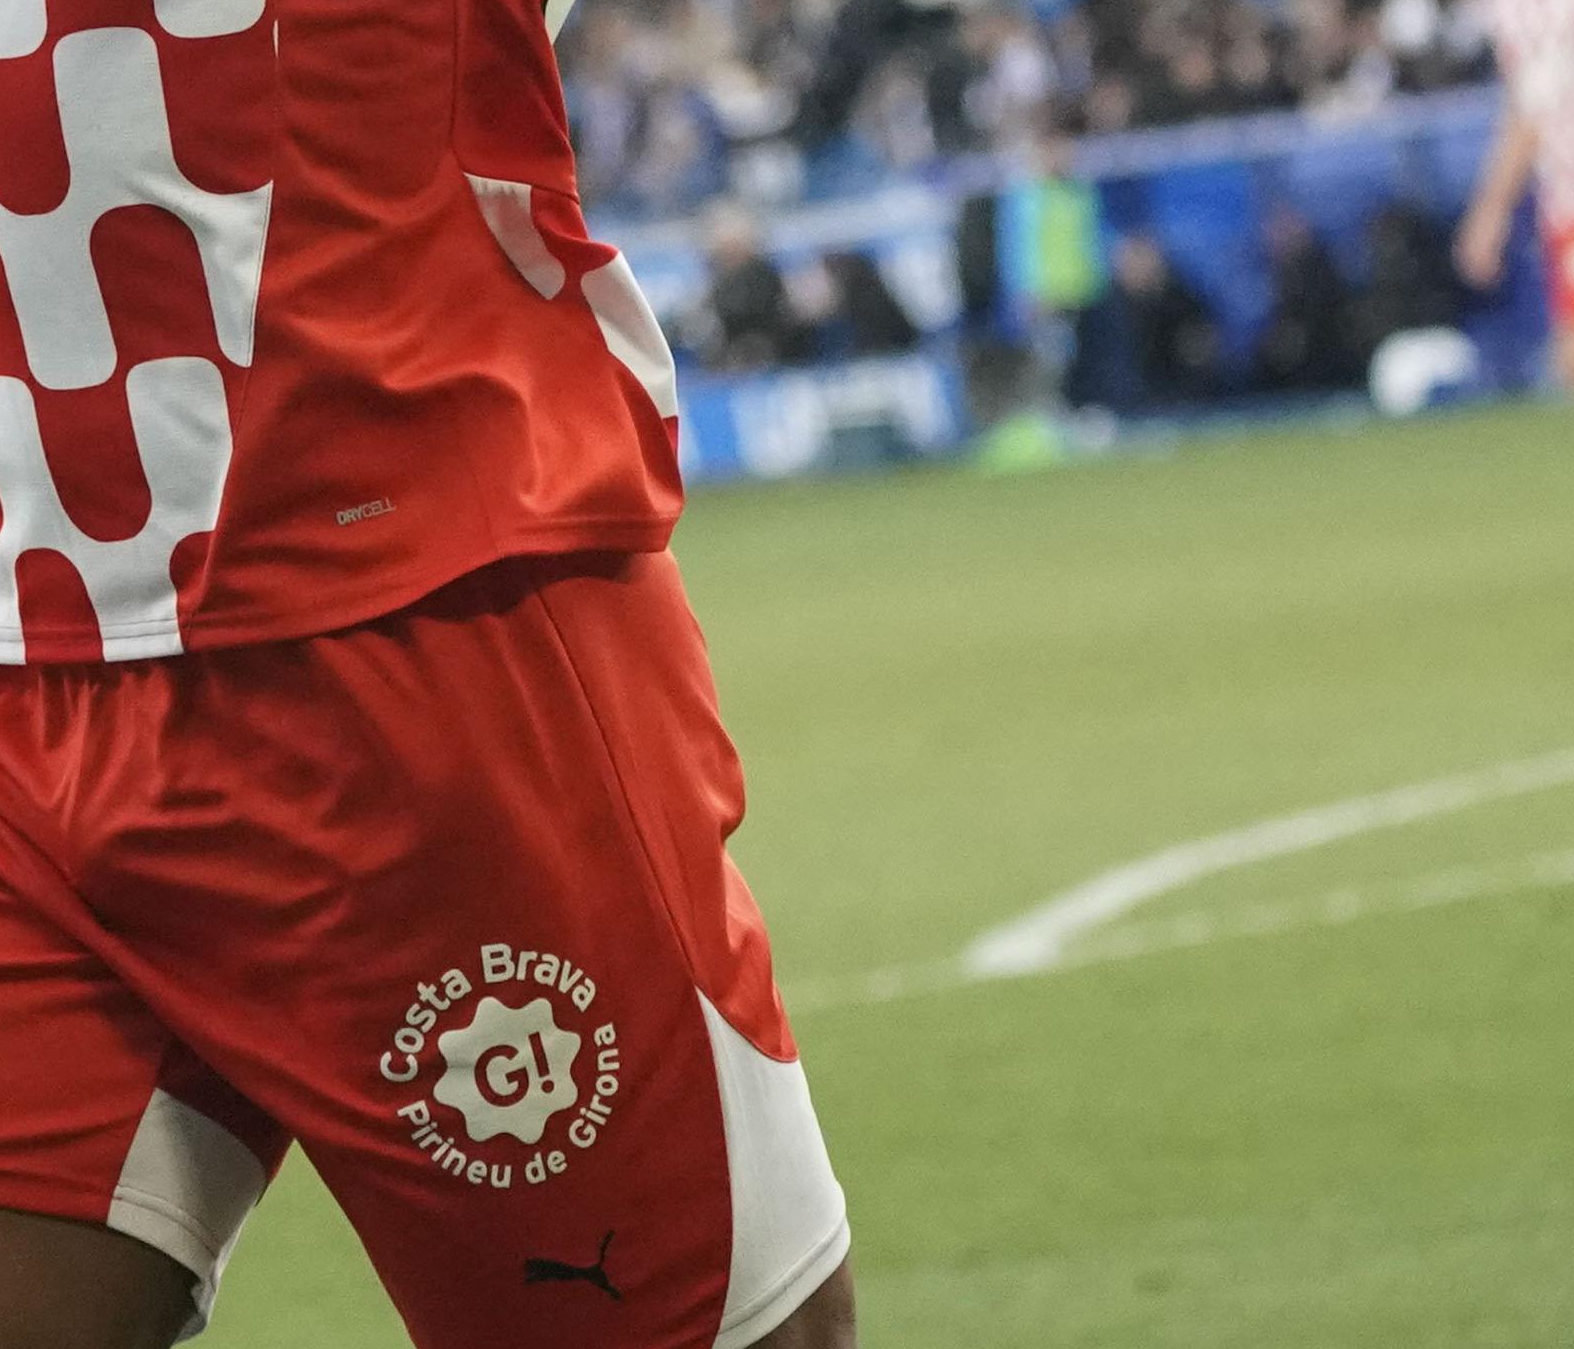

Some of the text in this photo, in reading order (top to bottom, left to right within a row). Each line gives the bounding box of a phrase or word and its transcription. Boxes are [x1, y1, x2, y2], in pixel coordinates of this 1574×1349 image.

[336, 497, 397, 525] DRYCELL
[379, 943, 596, 1082] Costa Brava
[397, 1022, 620, 1188] Pirineu de Girona
[474, 1031, 555, 1108] G!
